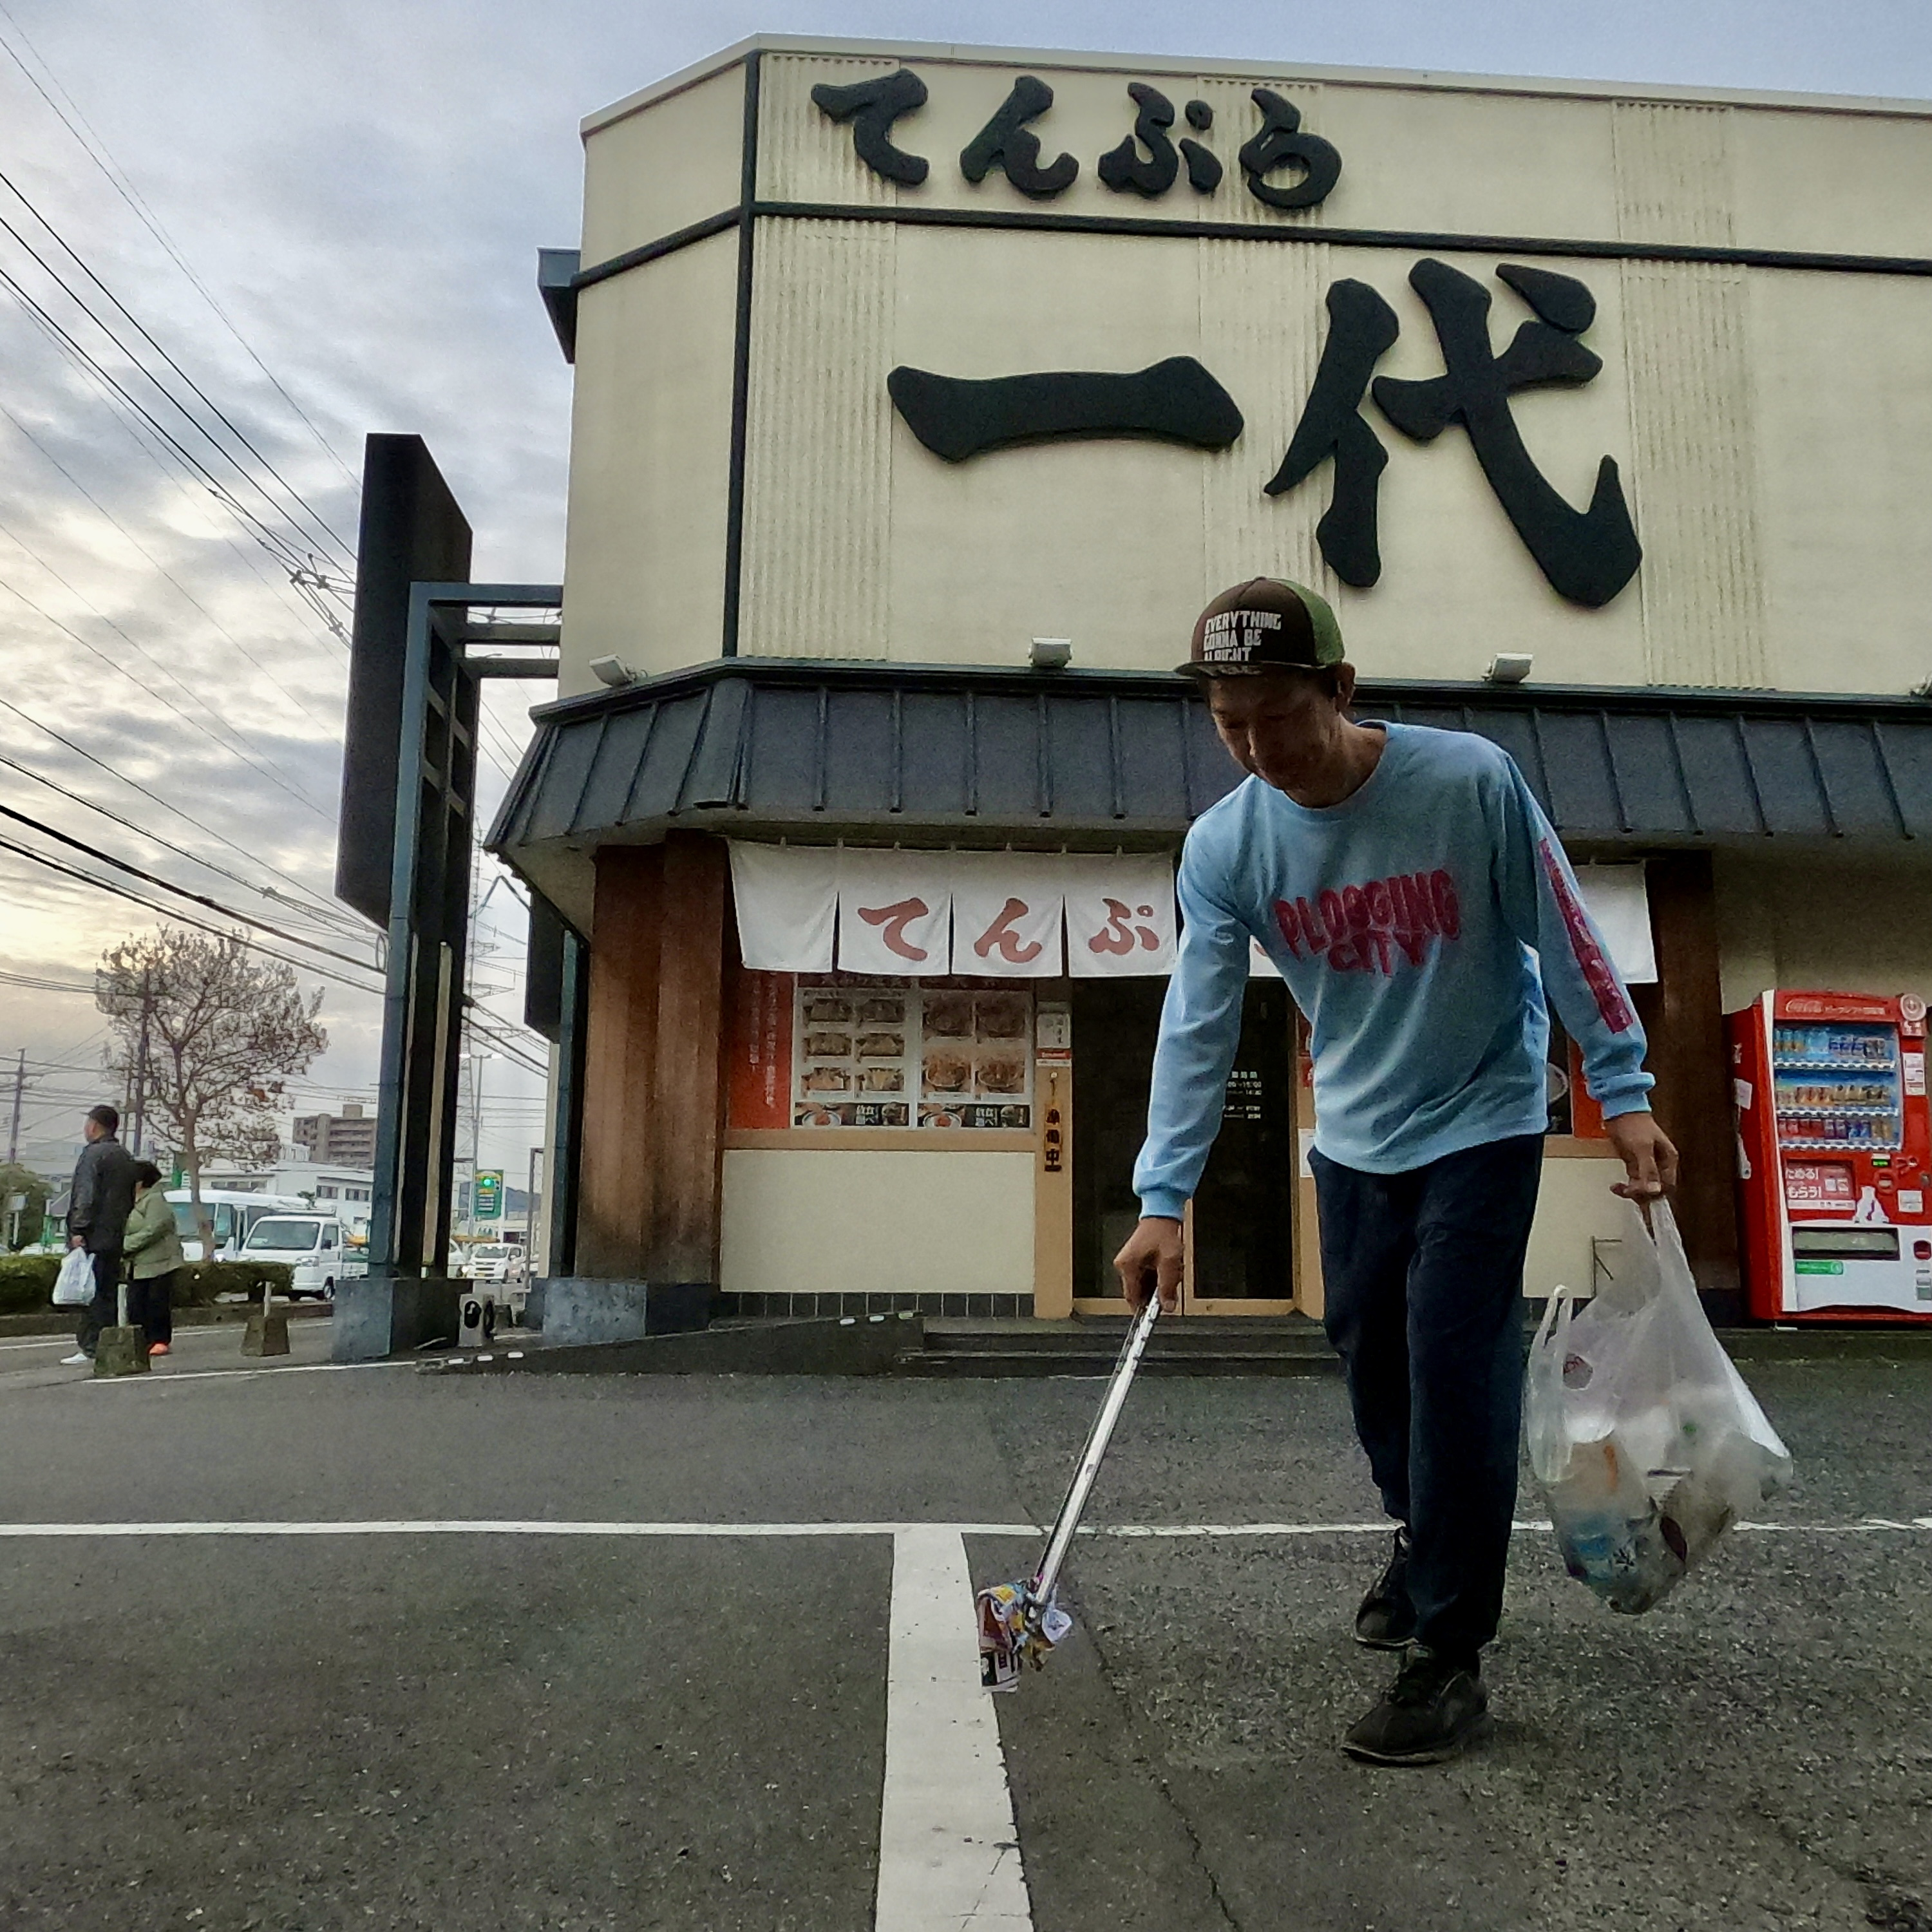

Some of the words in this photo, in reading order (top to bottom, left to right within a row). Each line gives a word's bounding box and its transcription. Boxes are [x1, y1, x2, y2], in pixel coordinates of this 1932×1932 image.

[887, 258, 1642, 607] 一代
[1203, 630, 1238, 652] GONNA
[1244, 629, 1262, 646] BE
[1204, 611, 1282, 634] EVERYTHING
[857, 897, 1267, 963] てんぷ
